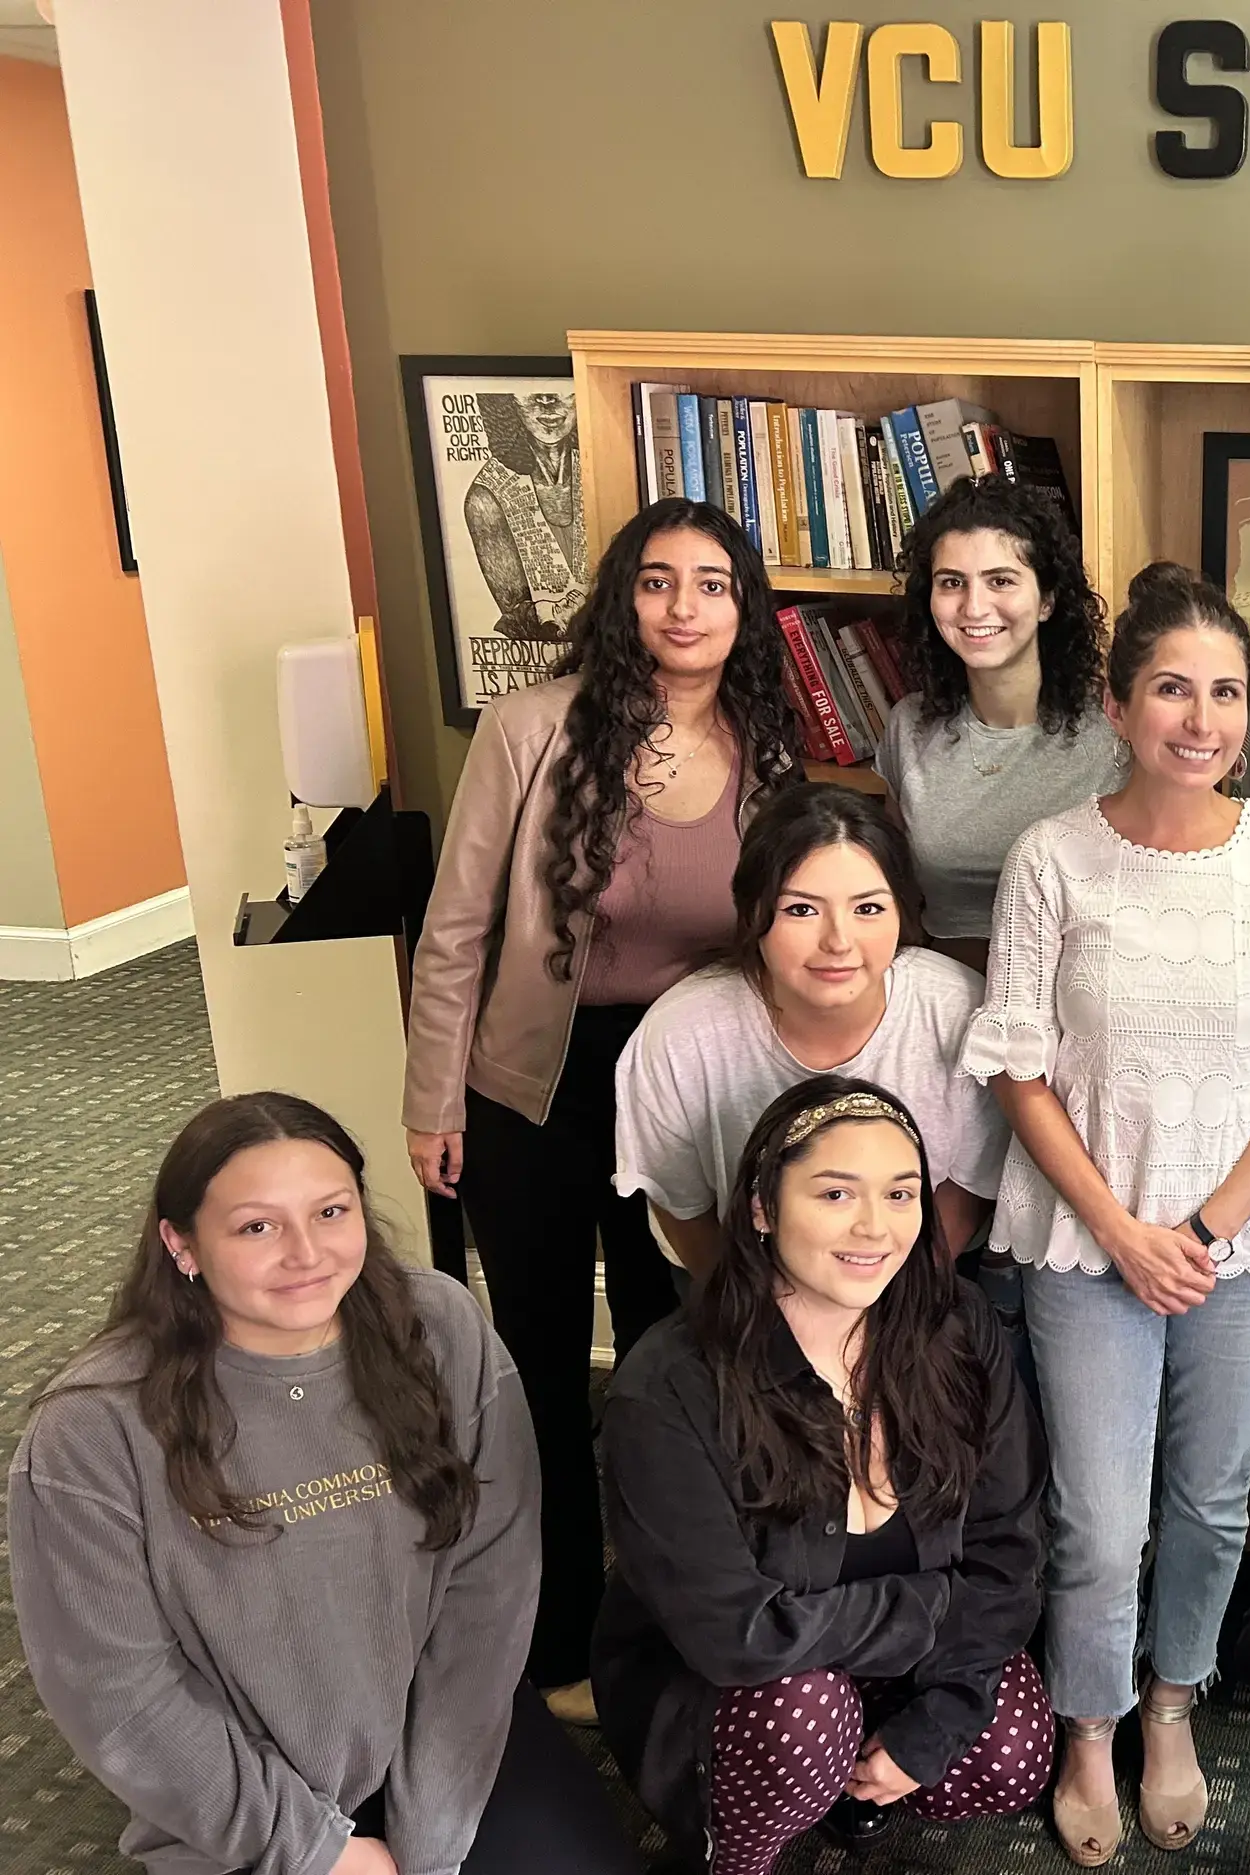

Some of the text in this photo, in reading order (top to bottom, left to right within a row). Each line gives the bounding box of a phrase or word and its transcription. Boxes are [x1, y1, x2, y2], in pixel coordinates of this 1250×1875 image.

[771, 20, 1075, 180] VCU
[442, 394, 476, 414] OUR
[443, 415, 483, 433] BODIES
[447, 447, 490, 461] RIGHTS
[450, 434, 480, 447] OUR
[737, 431, 748, 481] POPULATION
[772, 415, 784, 468] Introduction
[900, 433, 914, 467] Petersen
[664, 449, 675, 497] POPULA
[686, 440, 699, 492] POPULATION
[777, 469, 785, 478] to
[908, 430, 937, 501] POPULA
[1003, 460, 1015, 477] ONE
[777, 479, 789, 522] Population
[884, 474, 893, 505] Population
[890, 518, 898, 538] History
[898, 492, 907, 505] LESS
[481, 671, 500, 695] IS
[507, 671, 520, 694] A
[789, 630, 820, 688] EVERYTHING
[812, 689, 832, 716] FOR
[824, 718, 845, 748] SALE
[859, 688, 874, 711] THIS!
[190, 1463, 391, 1529] VINIA COMMON
[283, 1479, 393, 1524] UNIVERSIT
